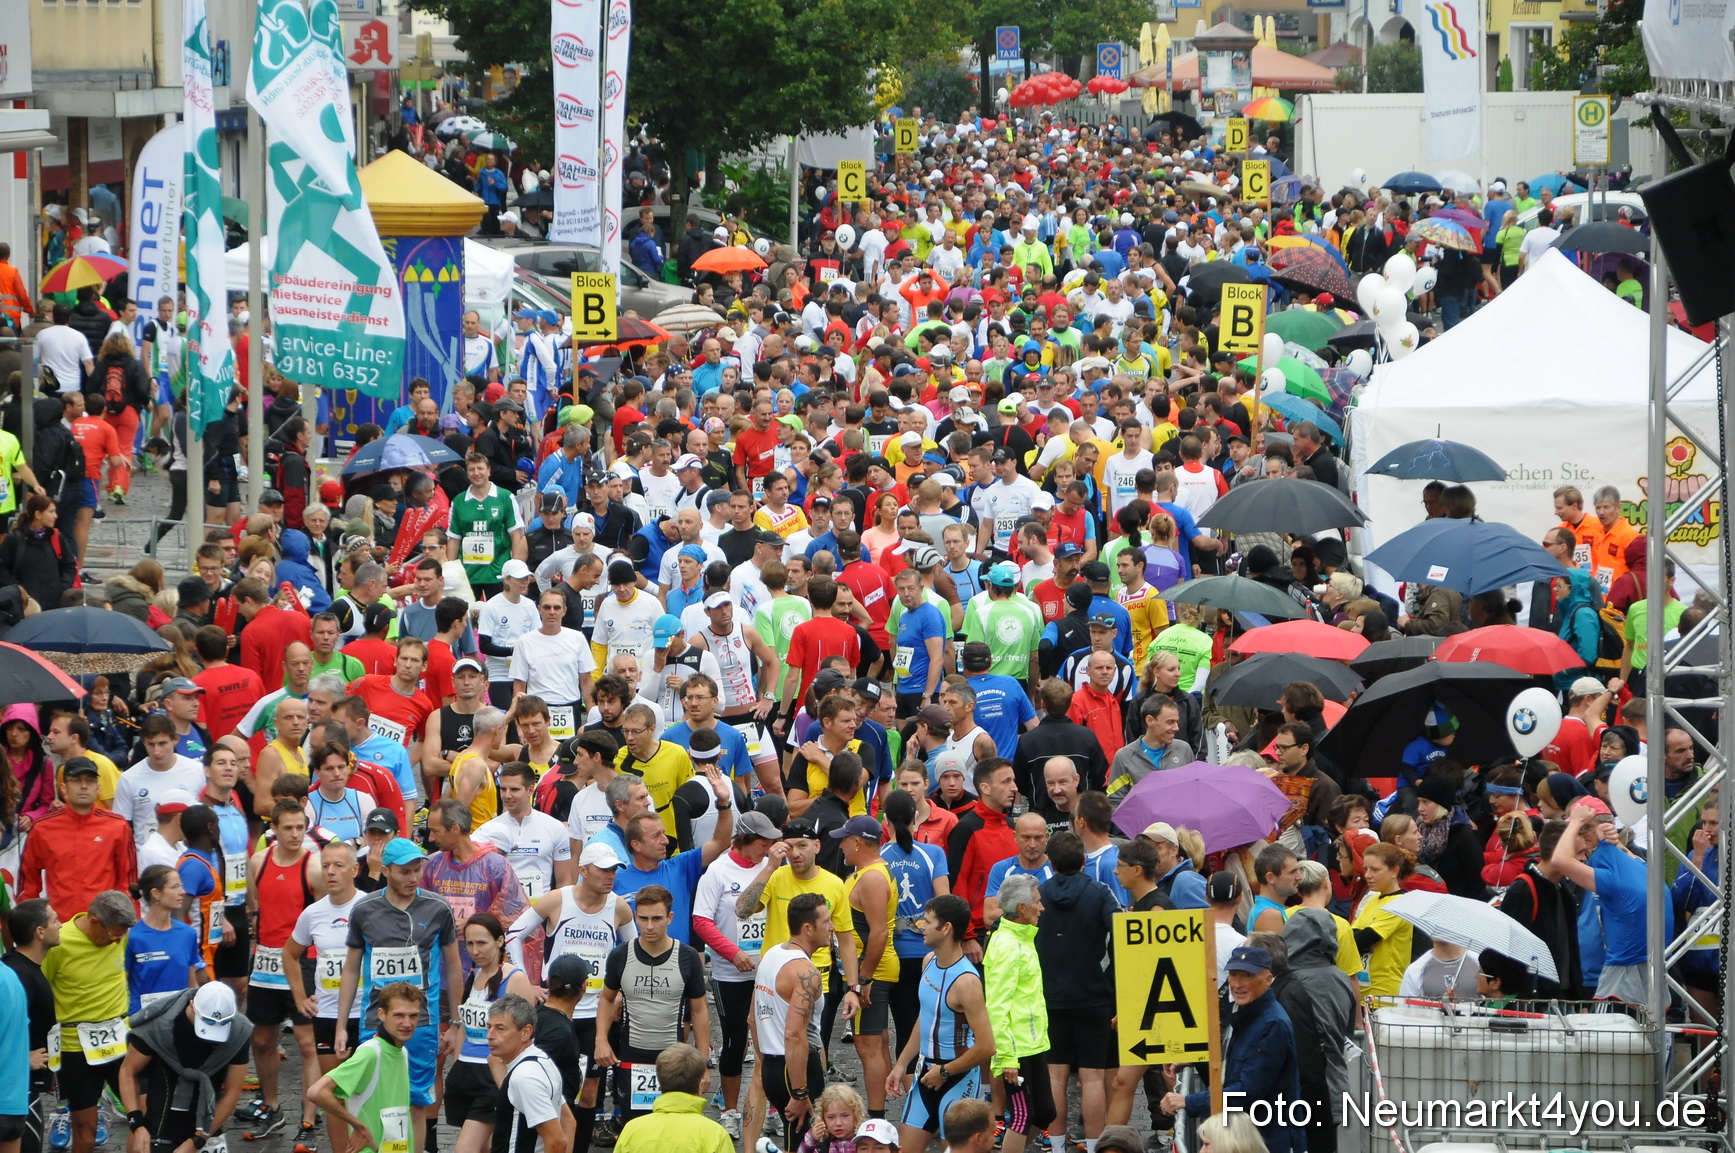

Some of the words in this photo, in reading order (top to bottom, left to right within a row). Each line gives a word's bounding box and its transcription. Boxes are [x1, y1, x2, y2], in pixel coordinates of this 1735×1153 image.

[1000, 49, 1018, 58] TAXI
[1100, 69, 1119, 79] TAXI
[1585, 106, 1598, 121] H
[897, 119, 916, 127] Block
[901, 129, 912, 145] D
[1232, 128, 1243, 145] D
[840, 161, 863, 170] Block
[1245, 161, 1267, 170] Block
[845, 172, 859, 193] C
[1249, 172, 1263, 193] C
[161, 251, 172, 296] ower
[576, 275, 611, 288] Block
[1227, 286, 1262, 300] Block
[584, 292, 606, 325] B
[1231, 304, 1254, 337] B
[281, 335, 393, 365] ervice-Line:
[278, 355, 325, 378] 9181
[332, 361, 380, 387] 6352
[1505, 462, 1554, 481] chen
[1561, 462, 1595, 480] Sie.
[472, 543, 485, 554] 46
[1575, 551, 1589, 563] 35
[583, 599, 594, 610] 03
[976, 688, 1007, 697] nrunners
[439, 887, 477, 896] STADTLAUF
[442, 880, 488, 891] NEUMARKTER
[564, 927, 609, 942] ERDINGER
[1126, 916, 1205, 945] Block
[376, 957, 418, 976] 2614
[634, 976, 670, 988] PESA
[633, 987, 672, 995] Blitzschutz
[1139, 957, 1198, 1031] A
[90, 1027, 119, 1047] 521
[101, 1047, 115, 1057] Ralf
[637, 1075, 659, 1092] 24
